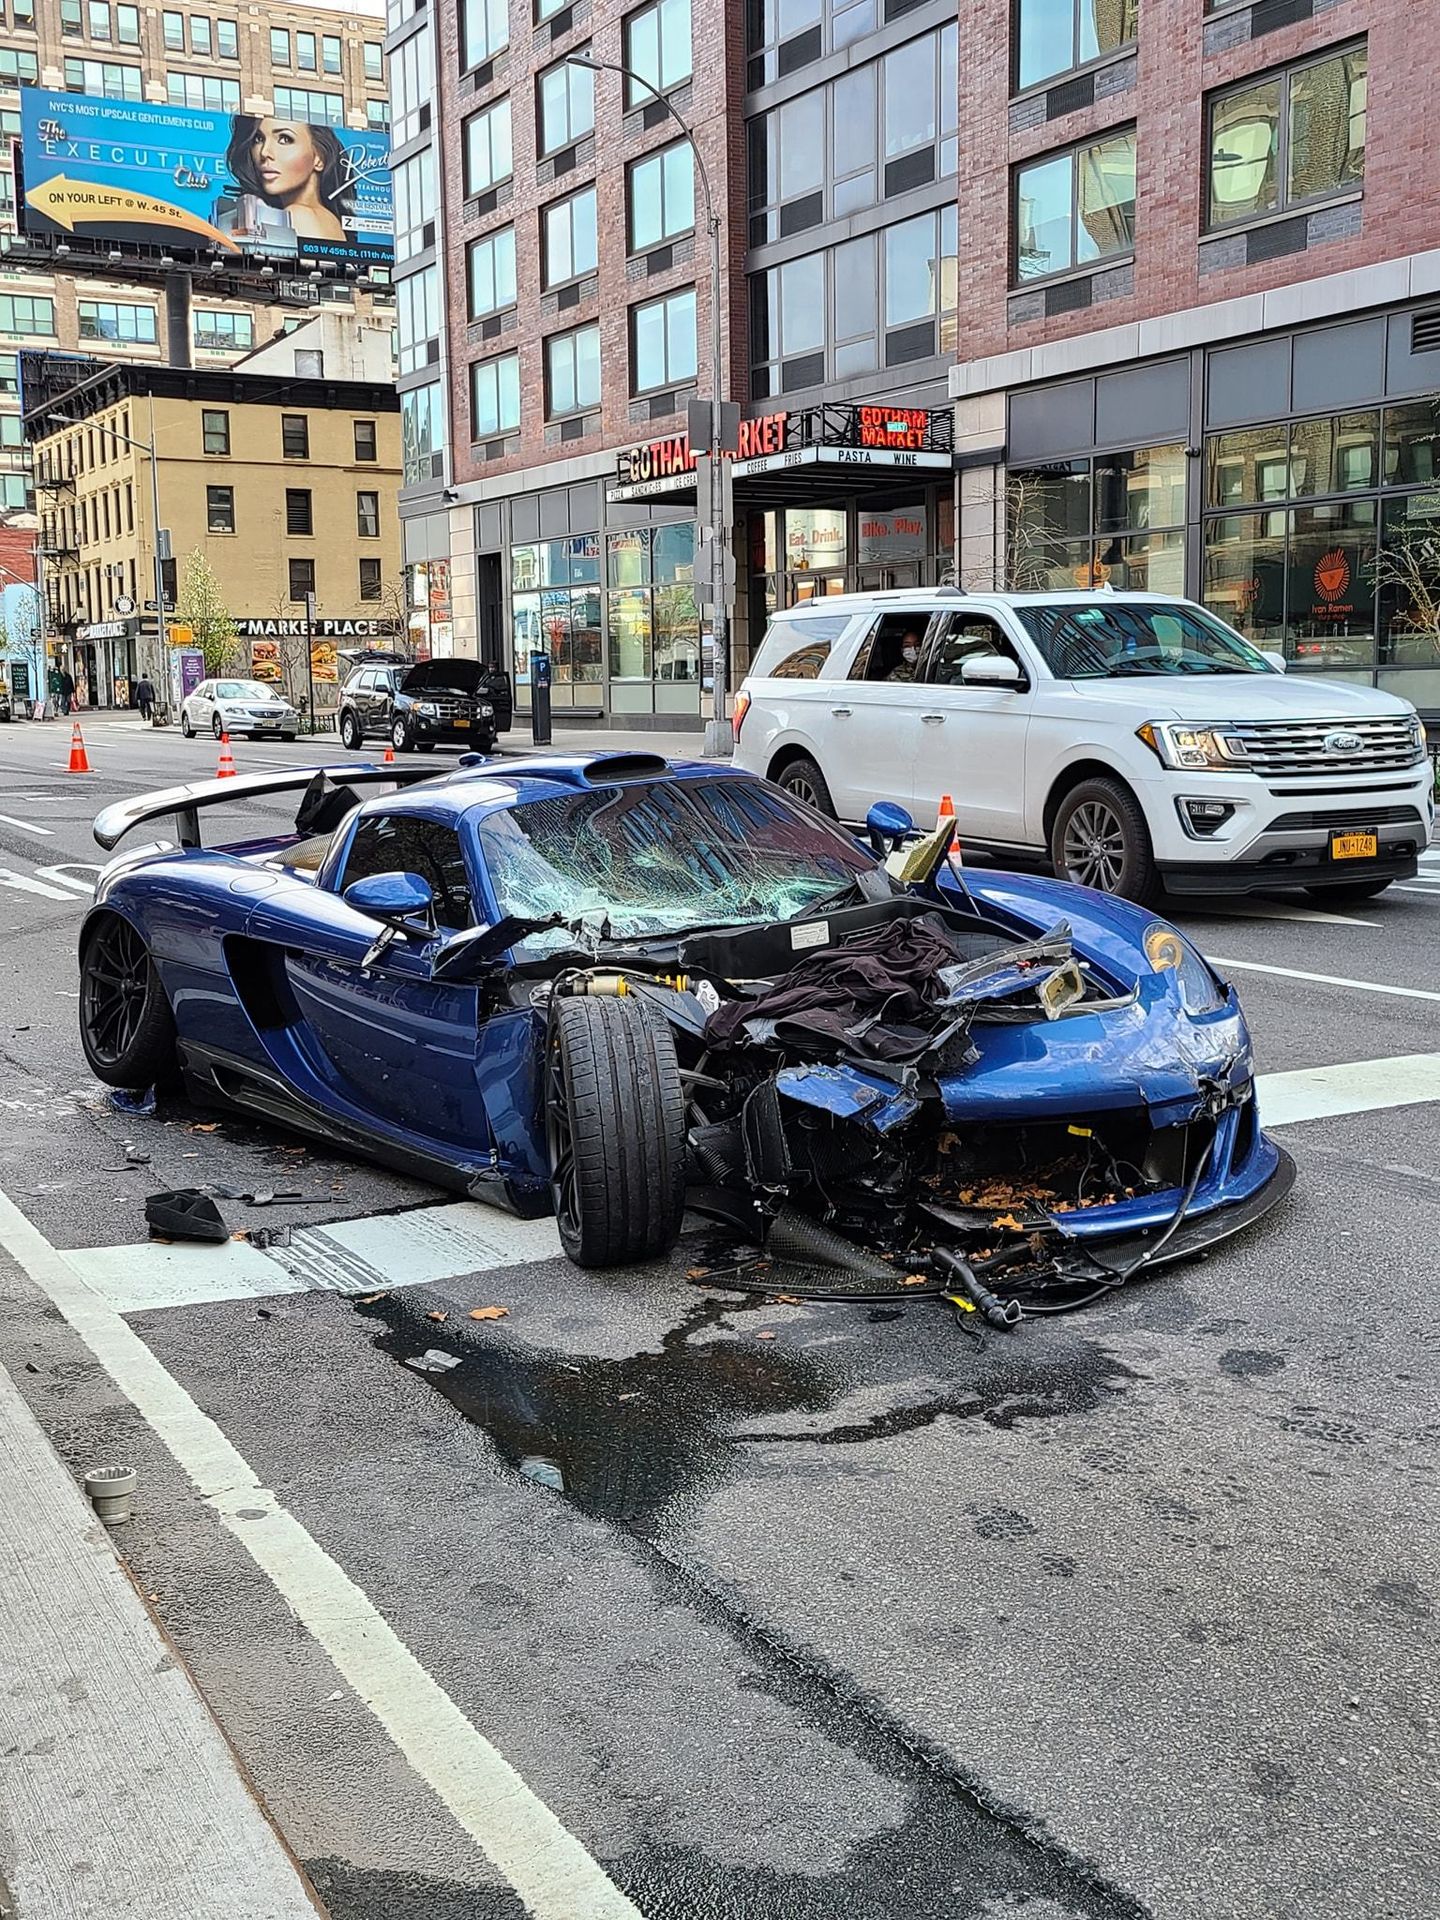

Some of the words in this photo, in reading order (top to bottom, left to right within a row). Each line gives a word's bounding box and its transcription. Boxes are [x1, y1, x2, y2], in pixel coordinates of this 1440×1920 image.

[49, 101, 75, 113] NYC'S
[75, 103, 99, 116] MOST
[101, 107, 137, 122] UPSCALE
[138, 112, 193, 129] GENTLEMEN'S
[193, 119, 214, 131] CLUB
[38, 118, 66, 141] The
[45, 139, 226, 175] EXECUTIVE
[174, 166, 212, 188] Club
[354, 184, 394, 194] STEAKHOU
[49, 193, 65, 204] ON
[67, 193, 96, 204] YOUR
[98, 195, 122, 206] LEFT
[125, 198, 135, 207] @
[136, 200, 150, 211] W.
[152, 204, 167, 214] 45
[168, 208, 183, 219] St.
[303, 244, 319, 253] 603
[320, 245, 329, 254] W
[329, 246, 348, 256] 45th
[348, 247, 359, 257] St.
[360, 248, 380, 259] (11th
[861, 406, 926, 428] GOTHAM
[861, 426, 925, 447] MARKET
[747, 459, 768, 474] COFFEE
[784, 452, 802, 467] FRIES
[838, 450, 872, 463] PASTA
[893, 453, 918, 465] WINE
[683, 475, 697, 487] CREA
[788, 532, 808, 547] Eat.
[811, 527, 843, 545] Drink.
[861, 521, 891, 538] Bike.
[894, 516, 924, 536] Play.
[1311, 603, 1328, 614] Ivan
[1328, 602, 1354, 614] Ramen
[323, 619, 378, 636] PLACE
[1336, 737, 1358, 748] Ford
